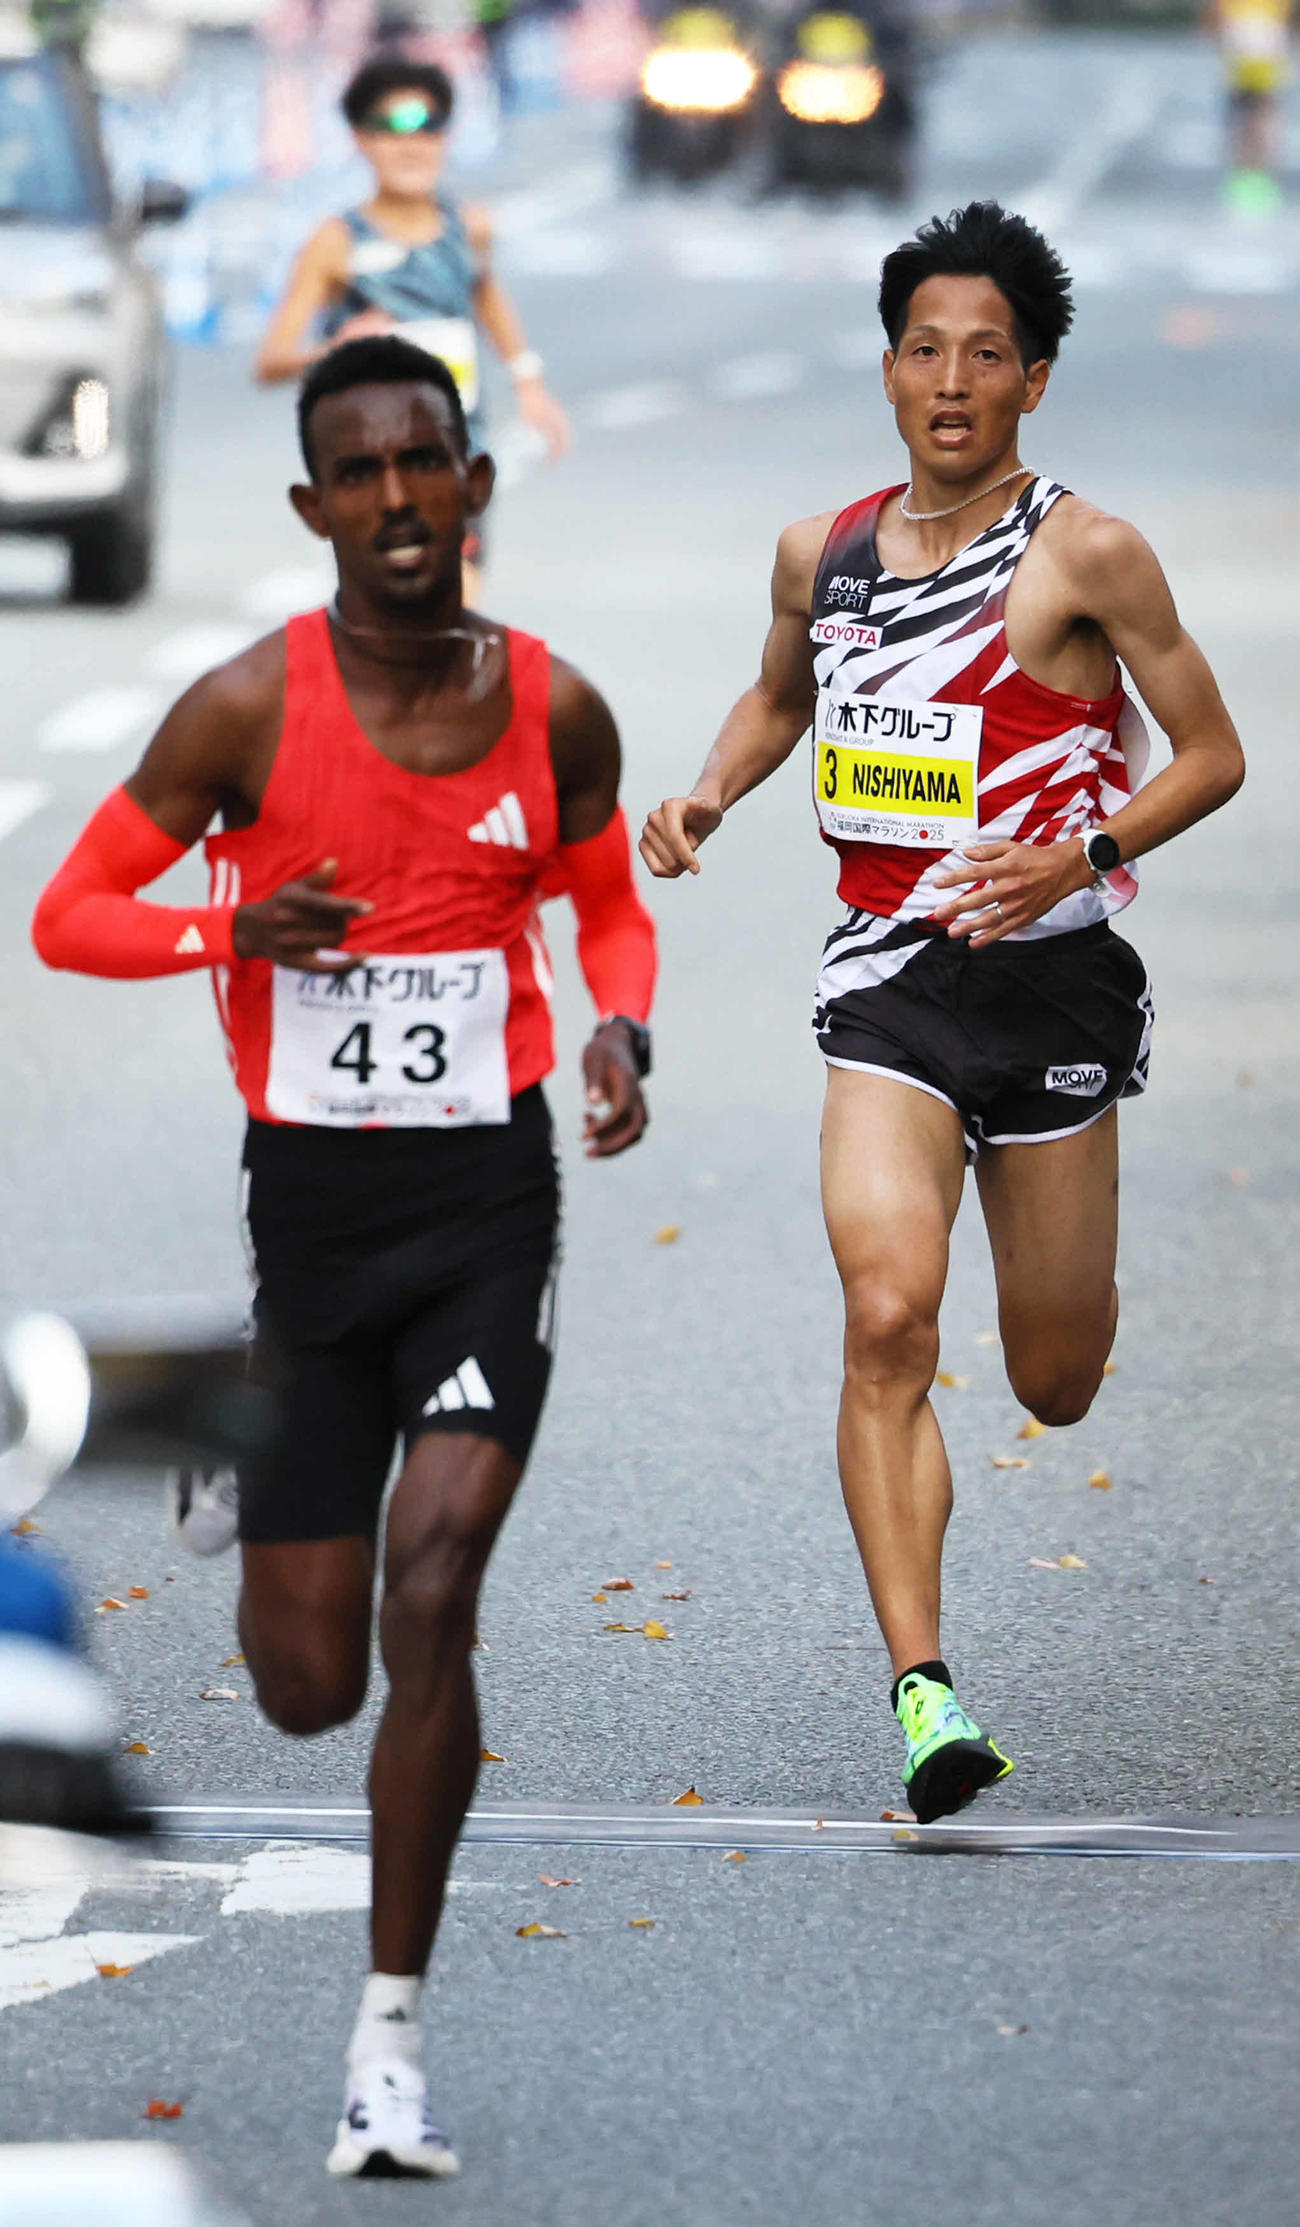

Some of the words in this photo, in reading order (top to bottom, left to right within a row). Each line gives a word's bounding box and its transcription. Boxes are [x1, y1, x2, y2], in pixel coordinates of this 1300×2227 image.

[824, 590, 868, 609] SPORT
[816, 624, 877, 645] TOYOTA
[837, 702, 957, 742] 木下グループ
[824, 748, 838, 799] 3
[852, 763, 962, 804] NISHIYAMA
